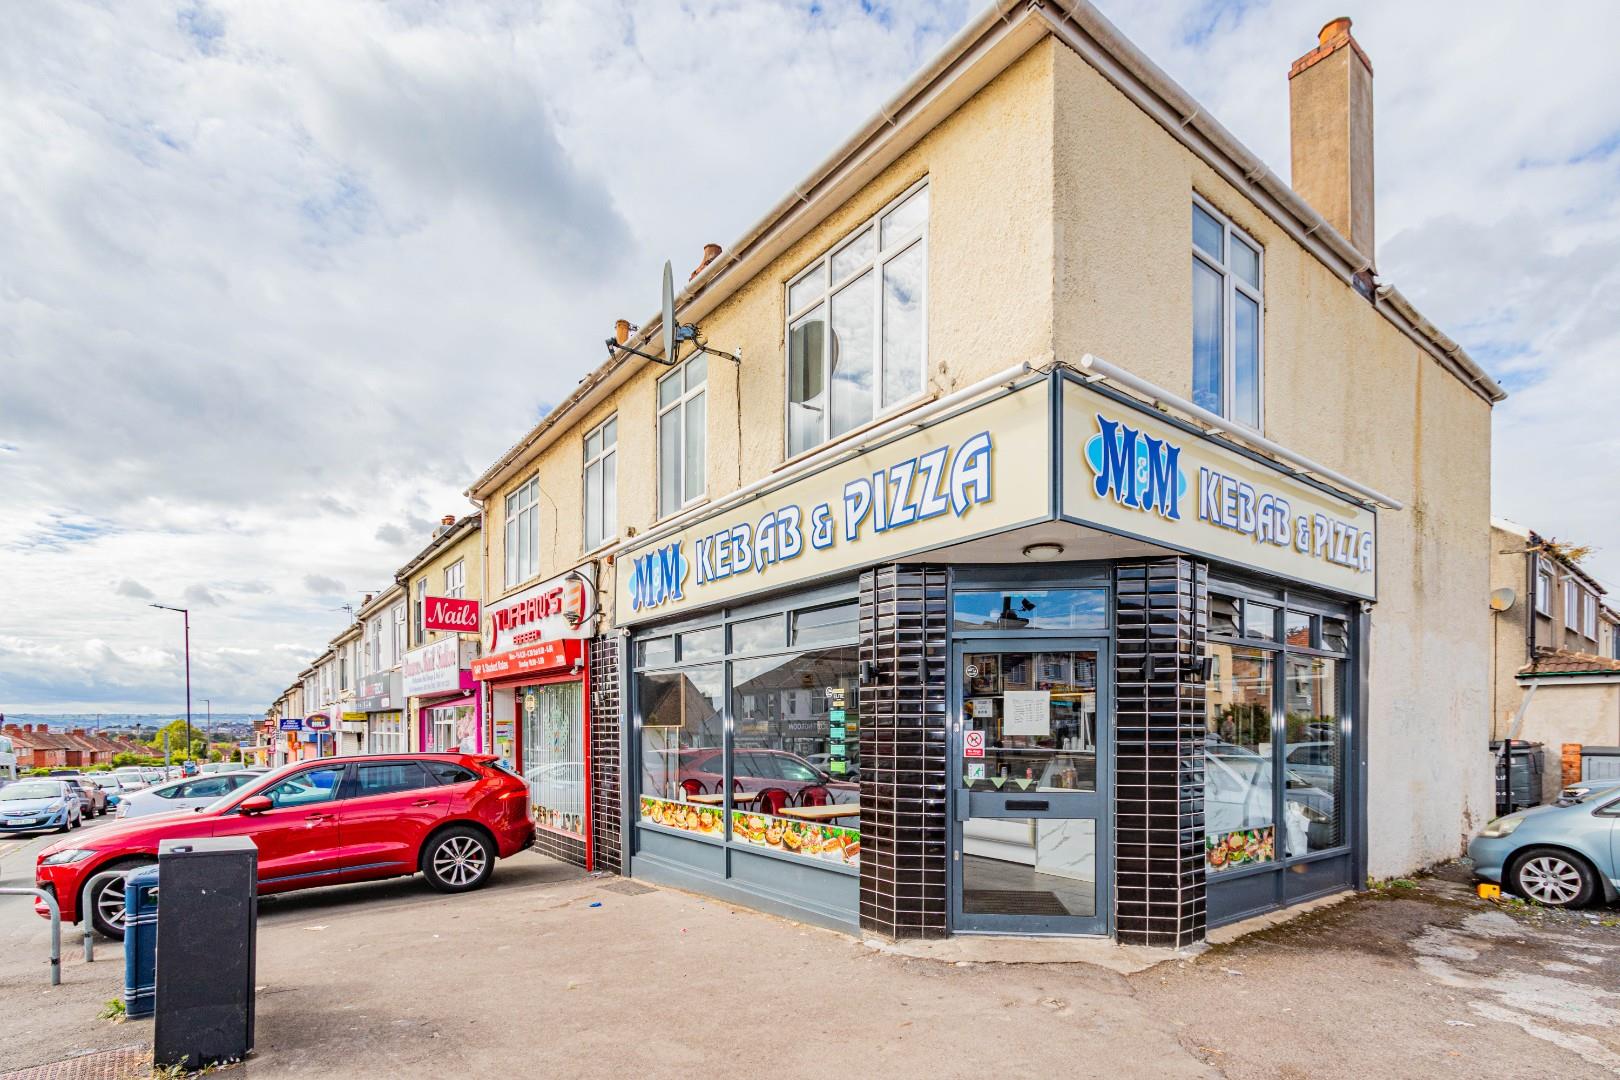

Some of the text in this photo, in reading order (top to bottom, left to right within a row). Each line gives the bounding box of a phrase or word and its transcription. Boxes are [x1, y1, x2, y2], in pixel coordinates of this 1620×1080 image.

[695, 504, 803, 586] KEBAB
[811, 502, 834, 550] &
[843, 430, 993, 542] PIZZA
[1199, 466, 1292, 548] KEBAB
[1296, 515, 1310, 553] &
[1315, 513, 1373, 574] PIZZA
[427, 601, 477, 626] Nails
